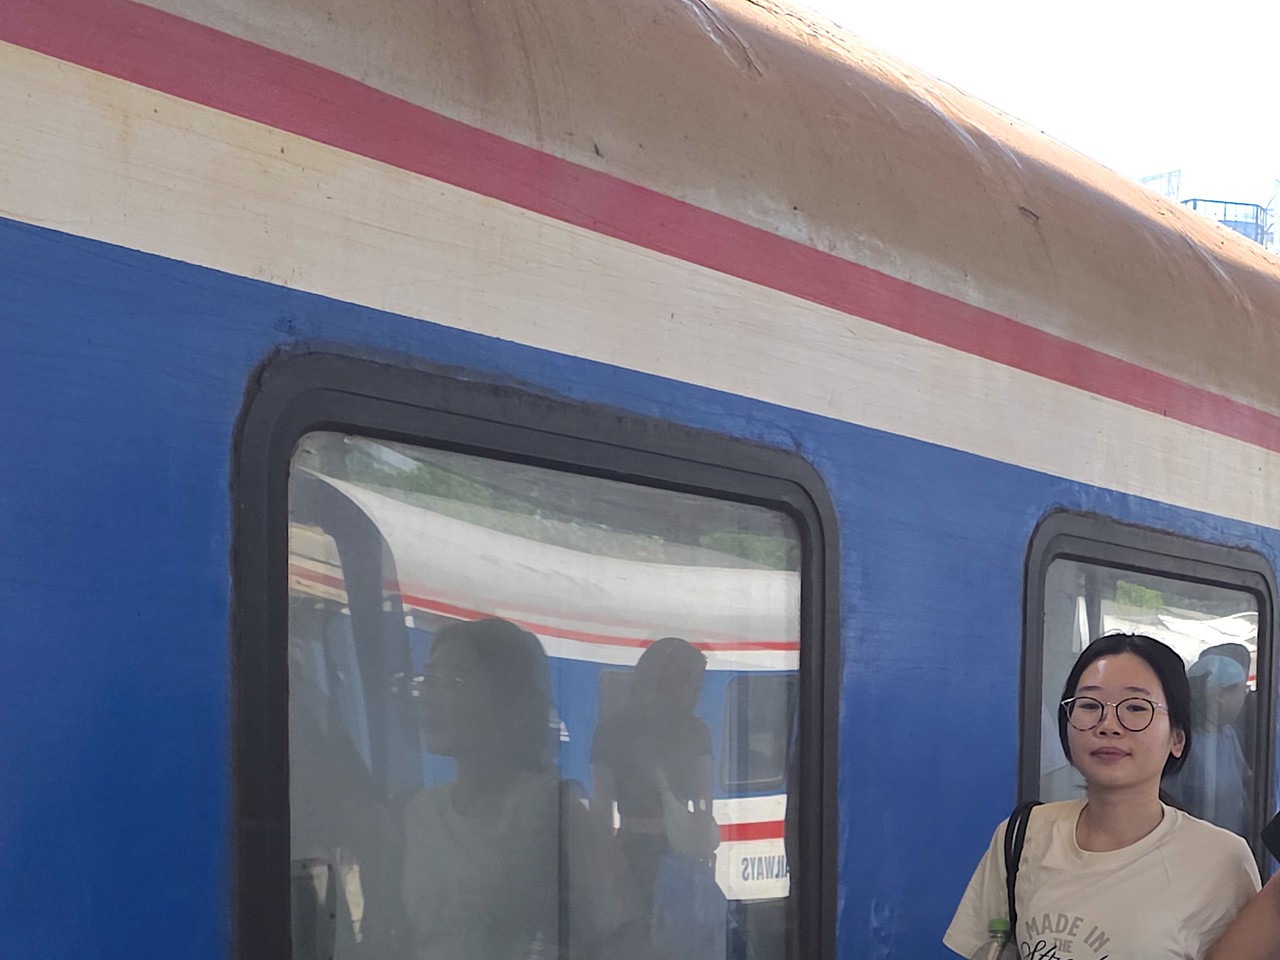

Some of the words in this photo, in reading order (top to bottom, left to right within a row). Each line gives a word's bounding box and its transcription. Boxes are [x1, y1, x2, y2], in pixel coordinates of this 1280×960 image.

[1025, 912, 1084, 941] MADE
[1083, 925, 1111, 954] IN
[1052, 937, 1074, 954] THE
